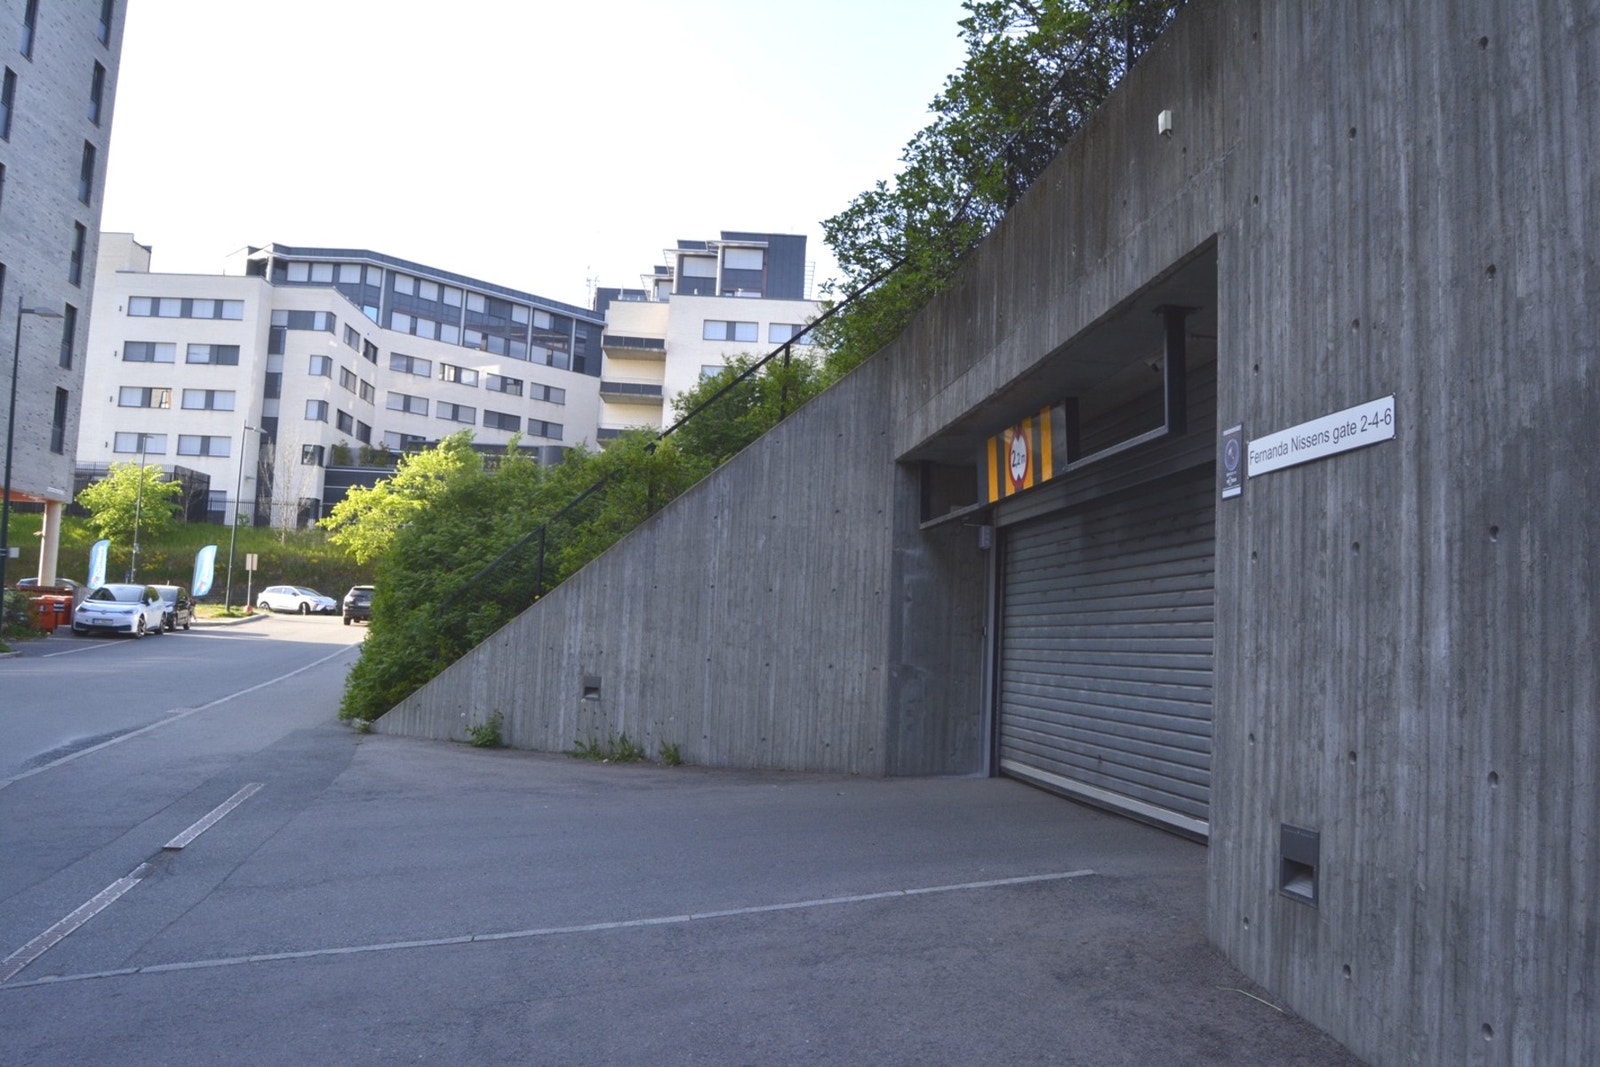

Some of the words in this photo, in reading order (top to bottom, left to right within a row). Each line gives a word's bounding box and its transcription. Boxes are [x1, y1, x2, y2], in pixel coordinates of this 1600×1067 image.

[1249, 443, 1289, 465] Fernanda
[1291, 431, 1330, 453] Nissens
[1333, 421, 1357, 444] gate
[1360, 408, 1392, 433] 2-4-6
